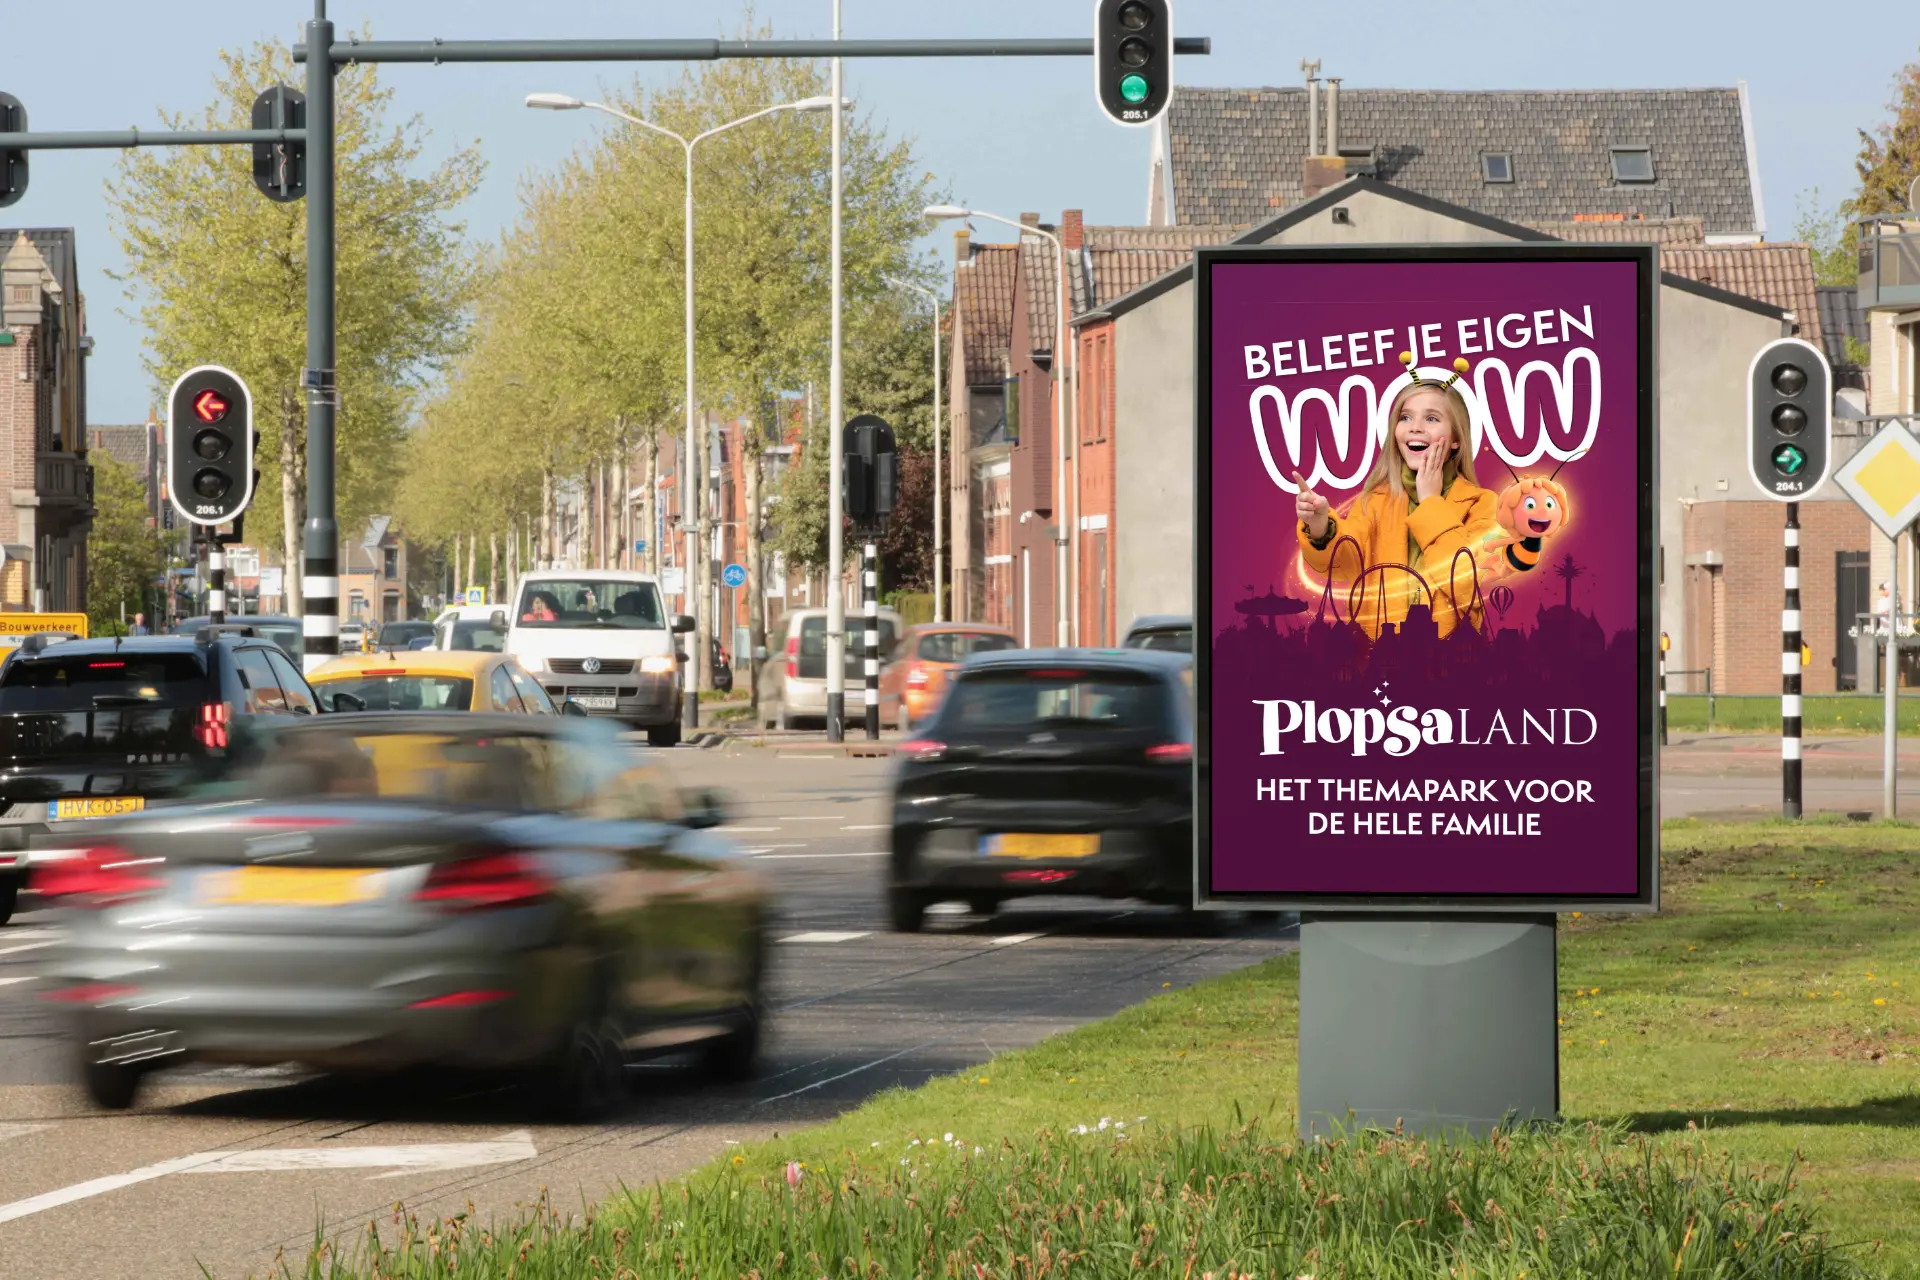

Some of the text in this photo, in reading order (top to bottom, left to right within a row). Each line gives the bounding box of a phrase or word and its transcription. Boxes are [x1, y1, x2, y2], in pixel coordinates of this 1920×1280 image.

[1123, 110, 1148, 119] 205.1
[1244, 304, 1594, 380] BELEEF JE EIGEN
[1249, 347, 1601, 495] WOW
[1775, 482, 1803, 491] 204.1
[196, 505, 223, 514] 206.1
[0, 622, 78, 632] Bouwverkeer
[1257, 779, 1595, 803] HET THEMAPARK VOOR
[1309, 812, 1541, 836] DE HELE FAMILIE
